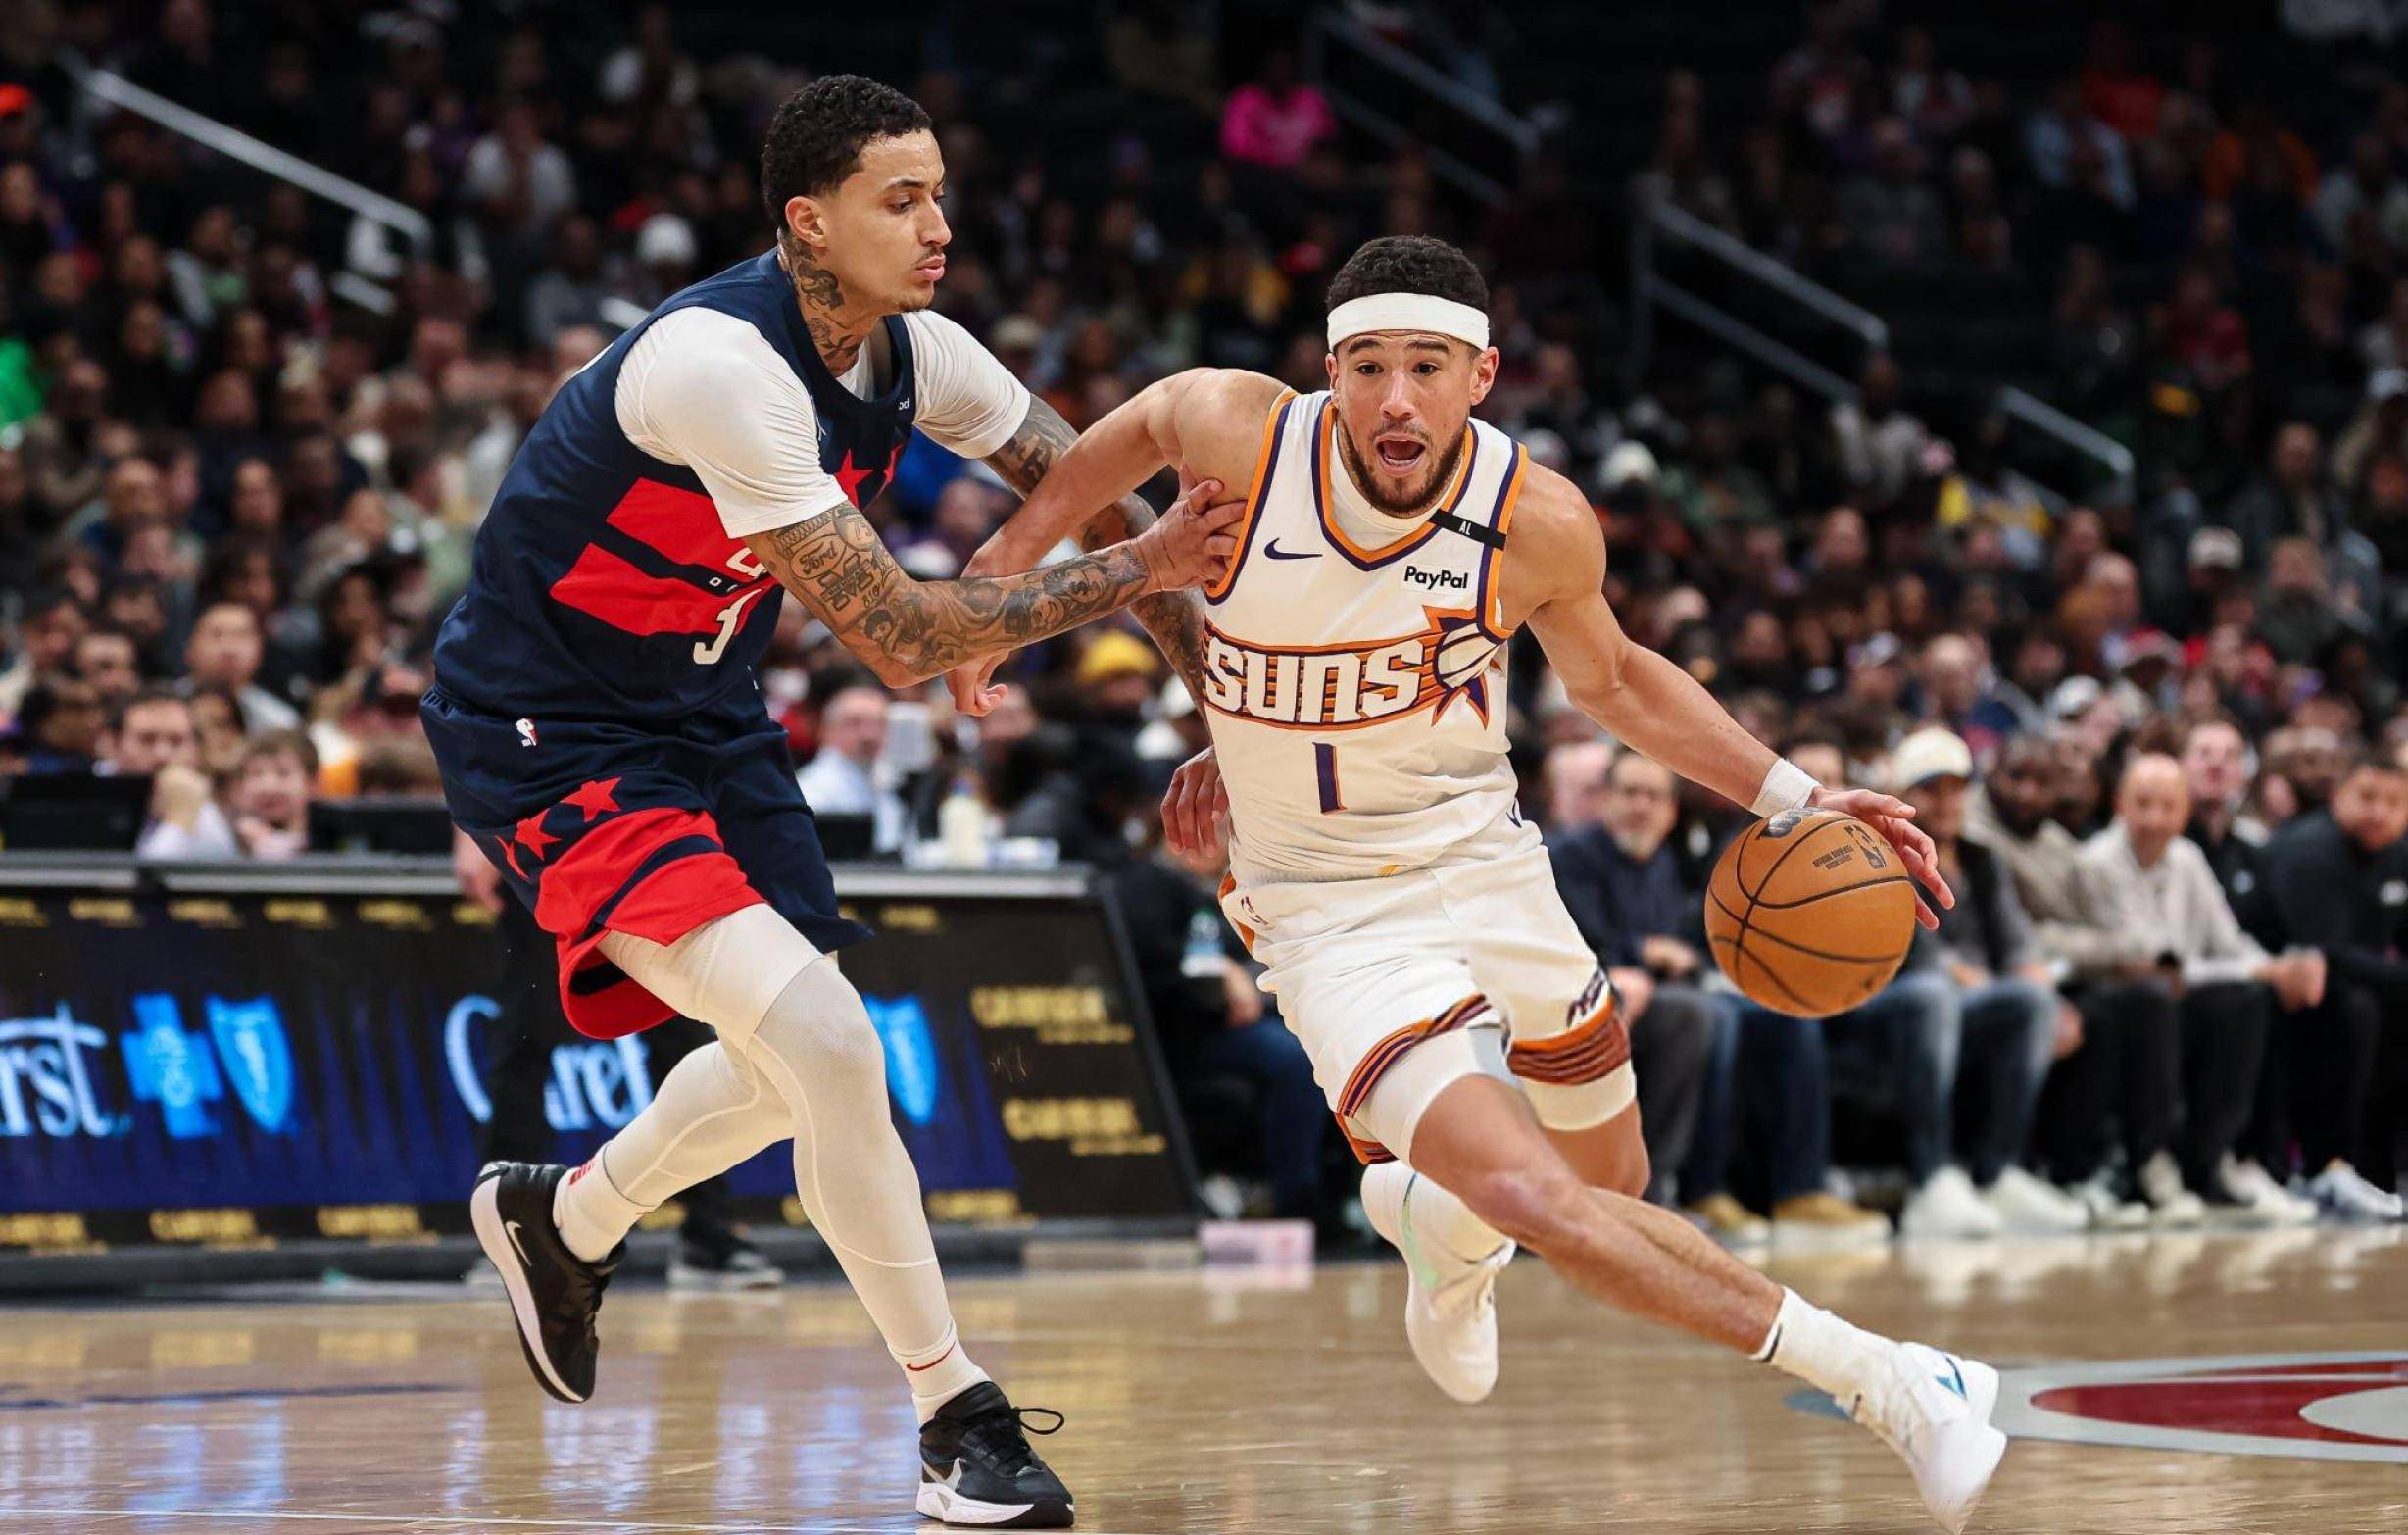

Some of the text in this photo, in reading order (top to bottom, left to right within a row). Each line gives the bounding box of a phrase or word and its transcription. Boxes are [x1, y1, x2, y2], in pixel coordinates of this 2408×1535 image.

[1458, 520, 1472, 536] AL
[799, 540, 838, 576] Ford
[1403, 565, 1469, 590] PayPal
[1206, 637, 1424, 724] SUNS
[1312, 742, 1349, 814] 1
[0, 999, 108, 1138] rst
